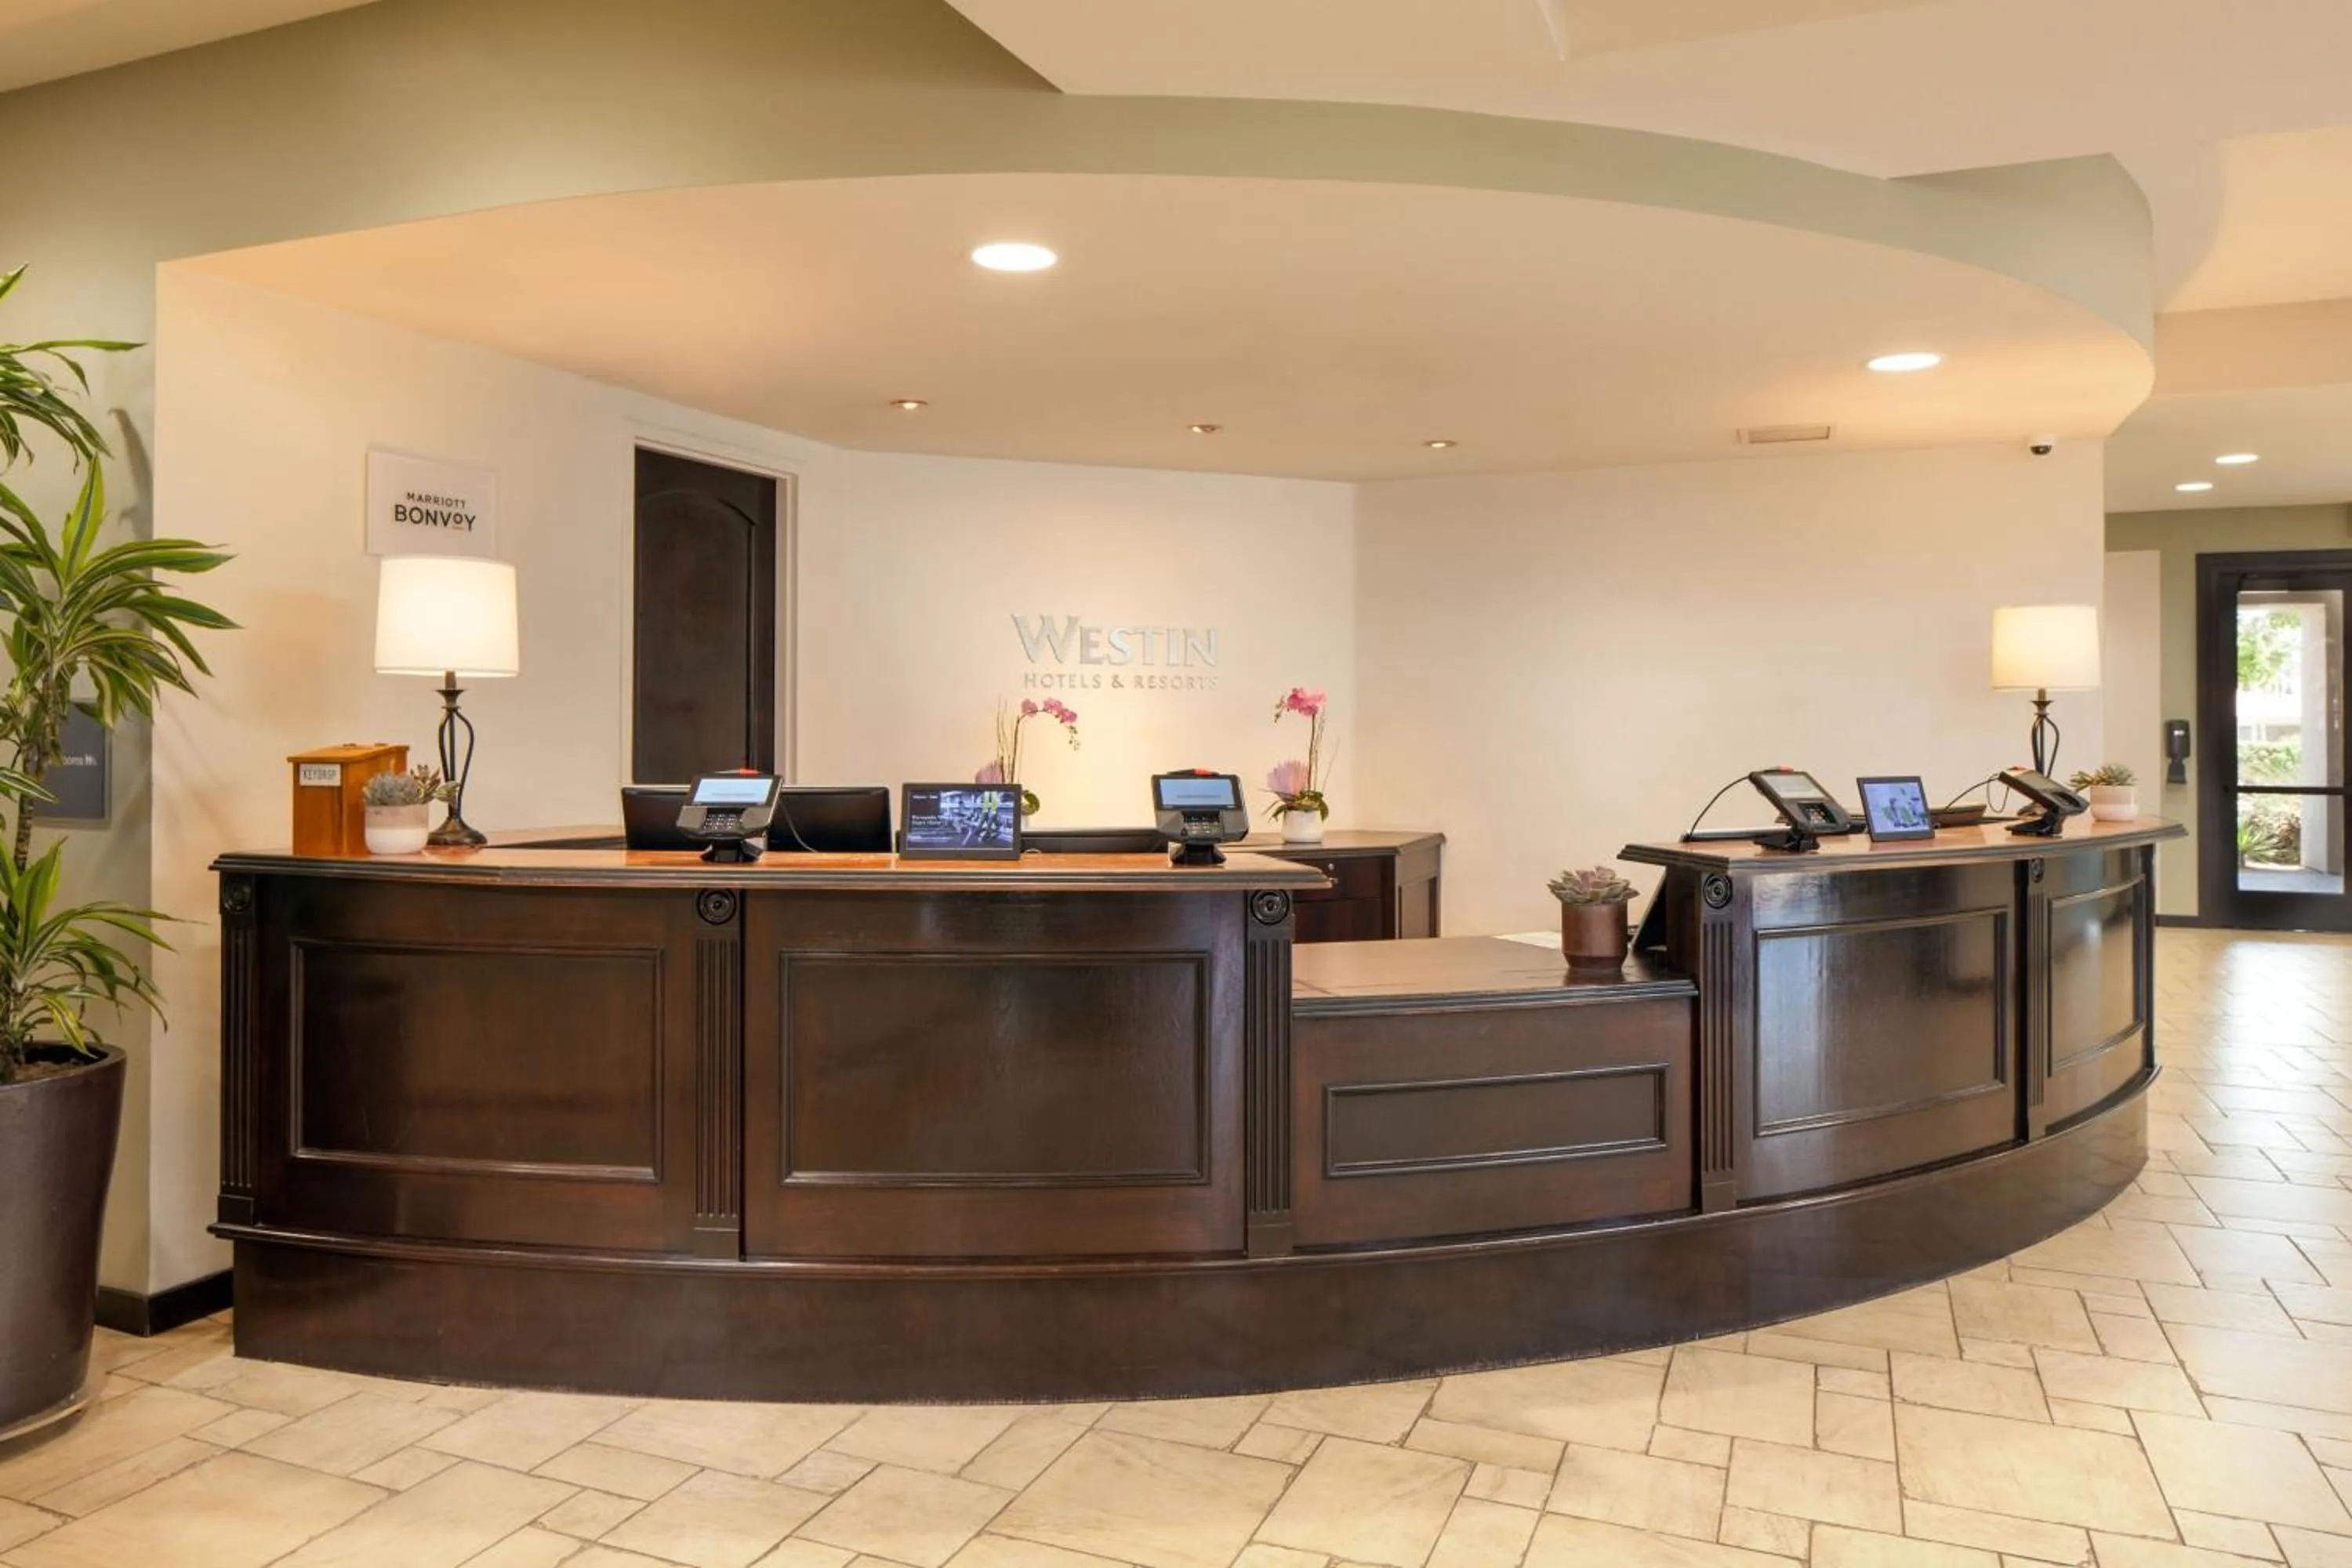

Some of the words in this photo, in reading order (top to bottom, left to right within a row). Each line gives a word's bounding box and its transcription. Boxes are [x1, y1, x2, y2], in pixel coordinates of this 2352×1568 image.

[406, 492, 466, 509] MARRIOTT
[394, 504, 476, 532] BONVOY
[1011, 613, 1218, 666] WESTIN
[1024, 673, 1102, 689] HOTELS
[1111, 675, 1124, 689] &
[1134, 675, 1218, 691] RESORTS
